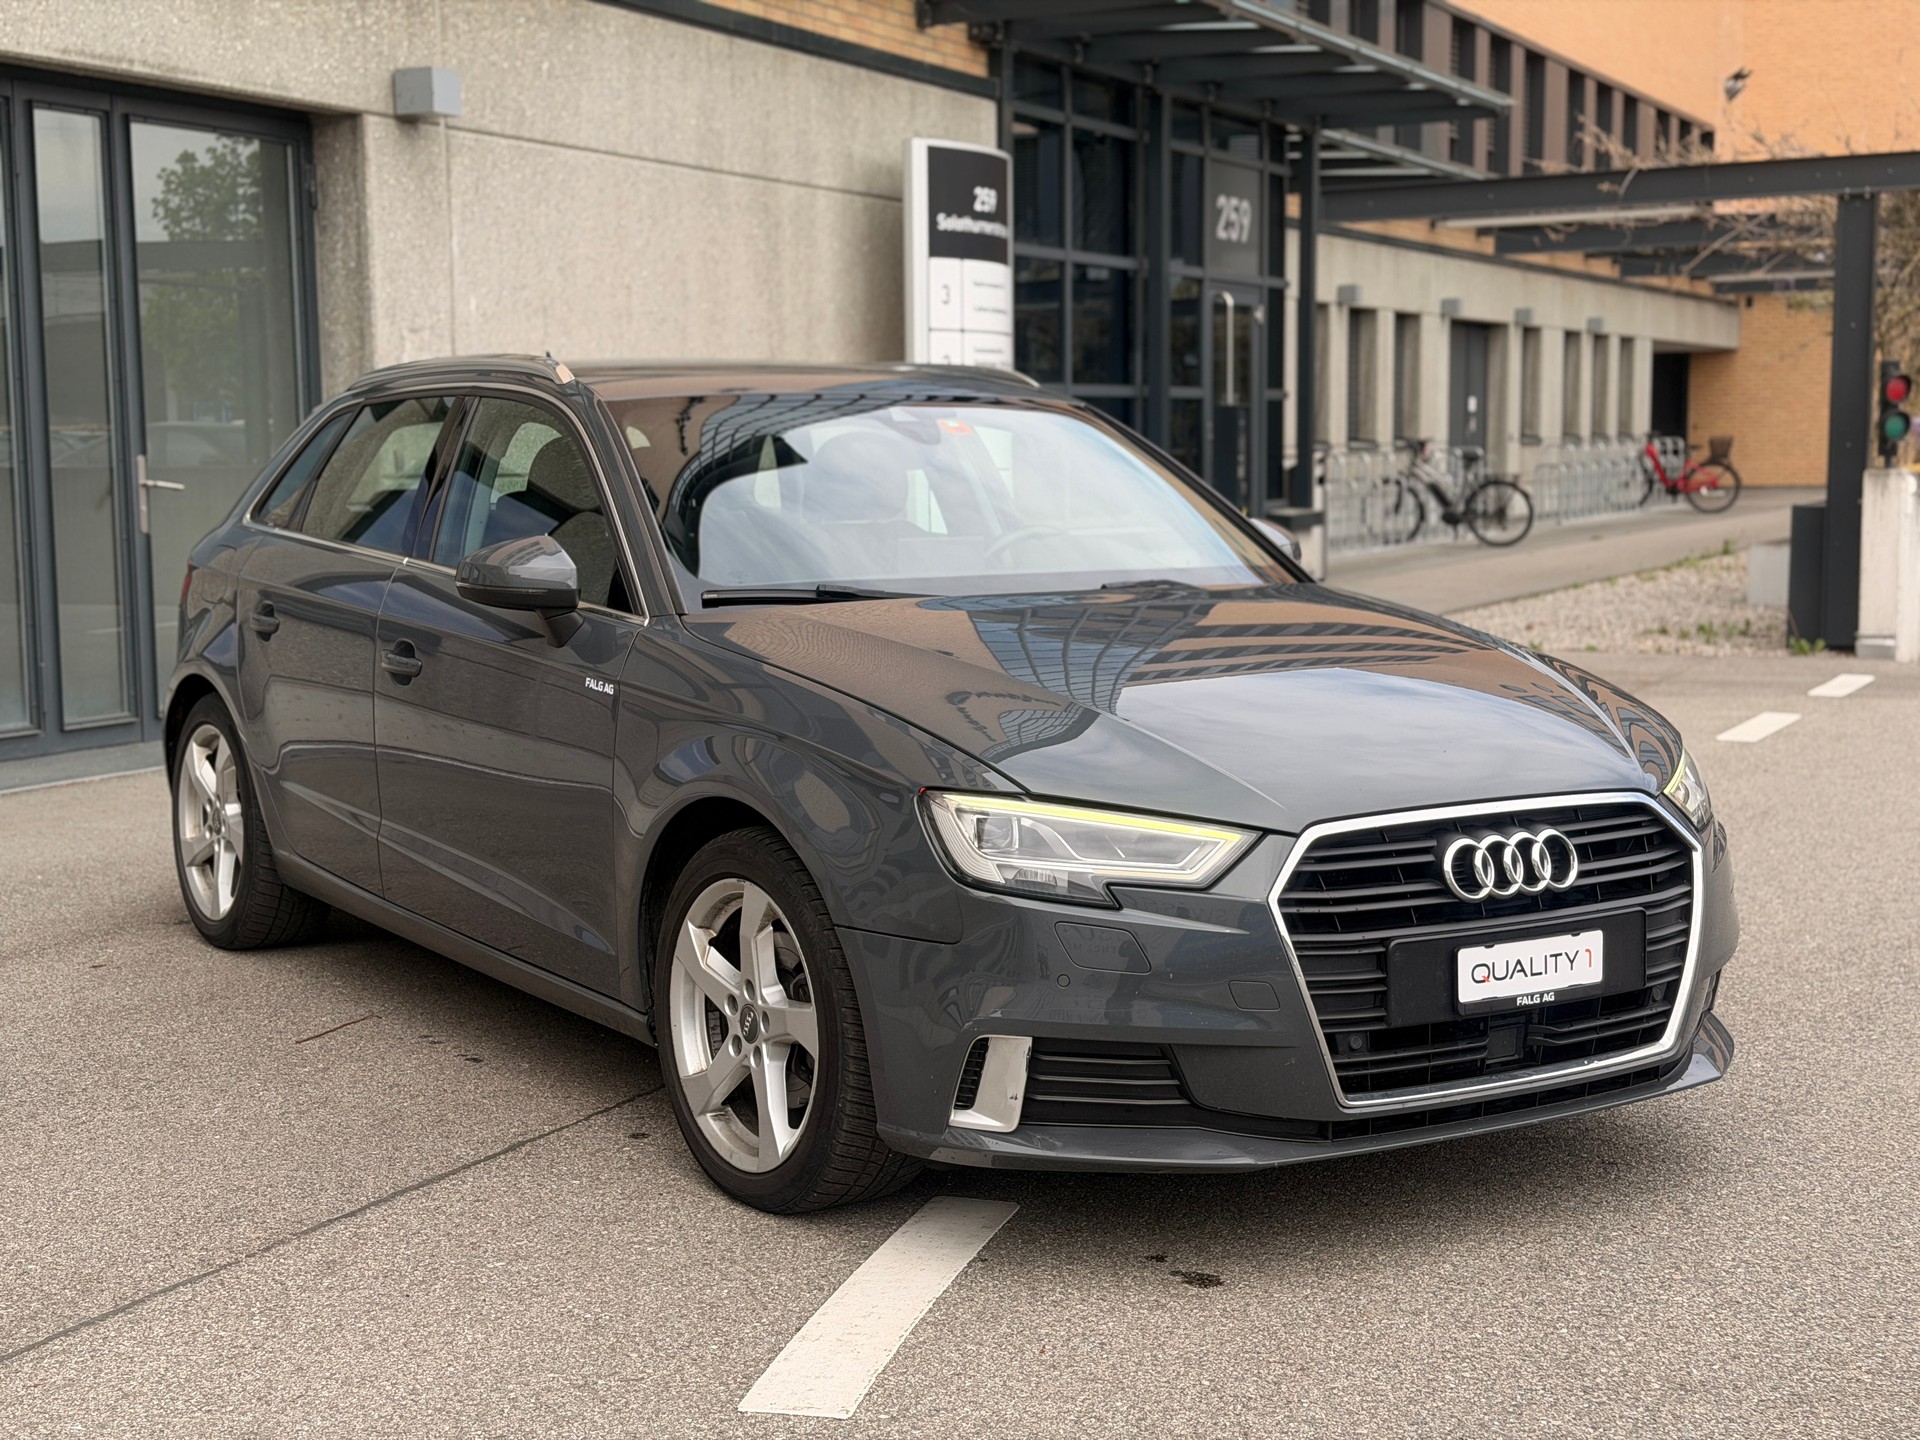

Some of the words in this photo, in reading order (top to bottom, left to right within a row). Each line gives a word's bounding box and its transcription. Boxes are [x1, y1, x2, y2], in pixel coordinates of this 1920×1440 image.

[1216, 194, 1251, 244] 259
[585, 677, 603, 692] FALG
[603, 682, 614, 695] AG
[1471, 949, 1580, 984] QUALITY
[1516, 993, 1541, 1007] FALG
[1542, 991, 1555, 1003] AG
